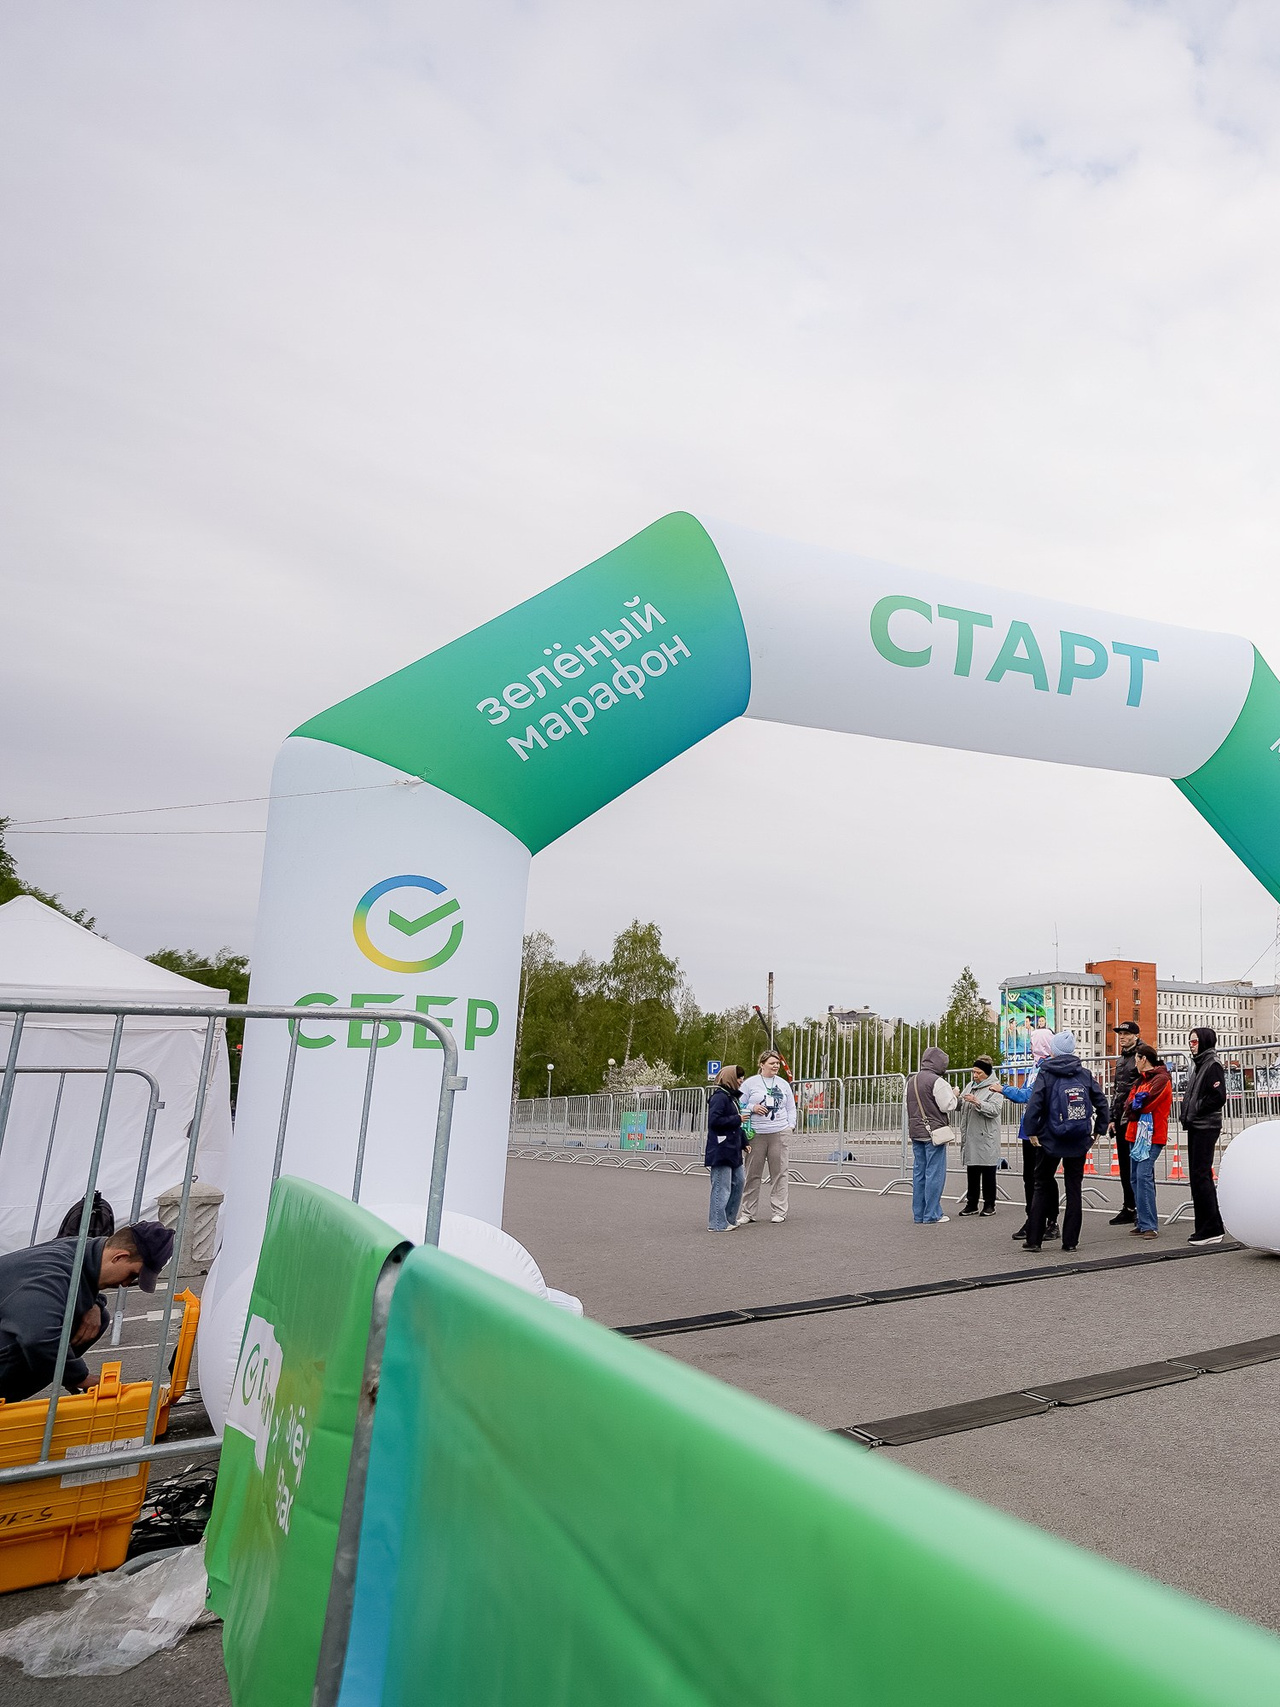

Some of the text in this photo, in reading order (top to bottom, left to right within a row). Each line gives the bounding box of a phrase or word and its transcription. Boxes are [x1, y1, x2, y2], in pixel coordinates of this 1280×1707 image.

[476, 595, 667, 726] зелёный
[506, 634, 692, 762] марафон
[869, 594, 1160, 709] СТАРТ
[288, 992, 500, 1051] СБЕР
[711, 1062, 719, 1074] P
